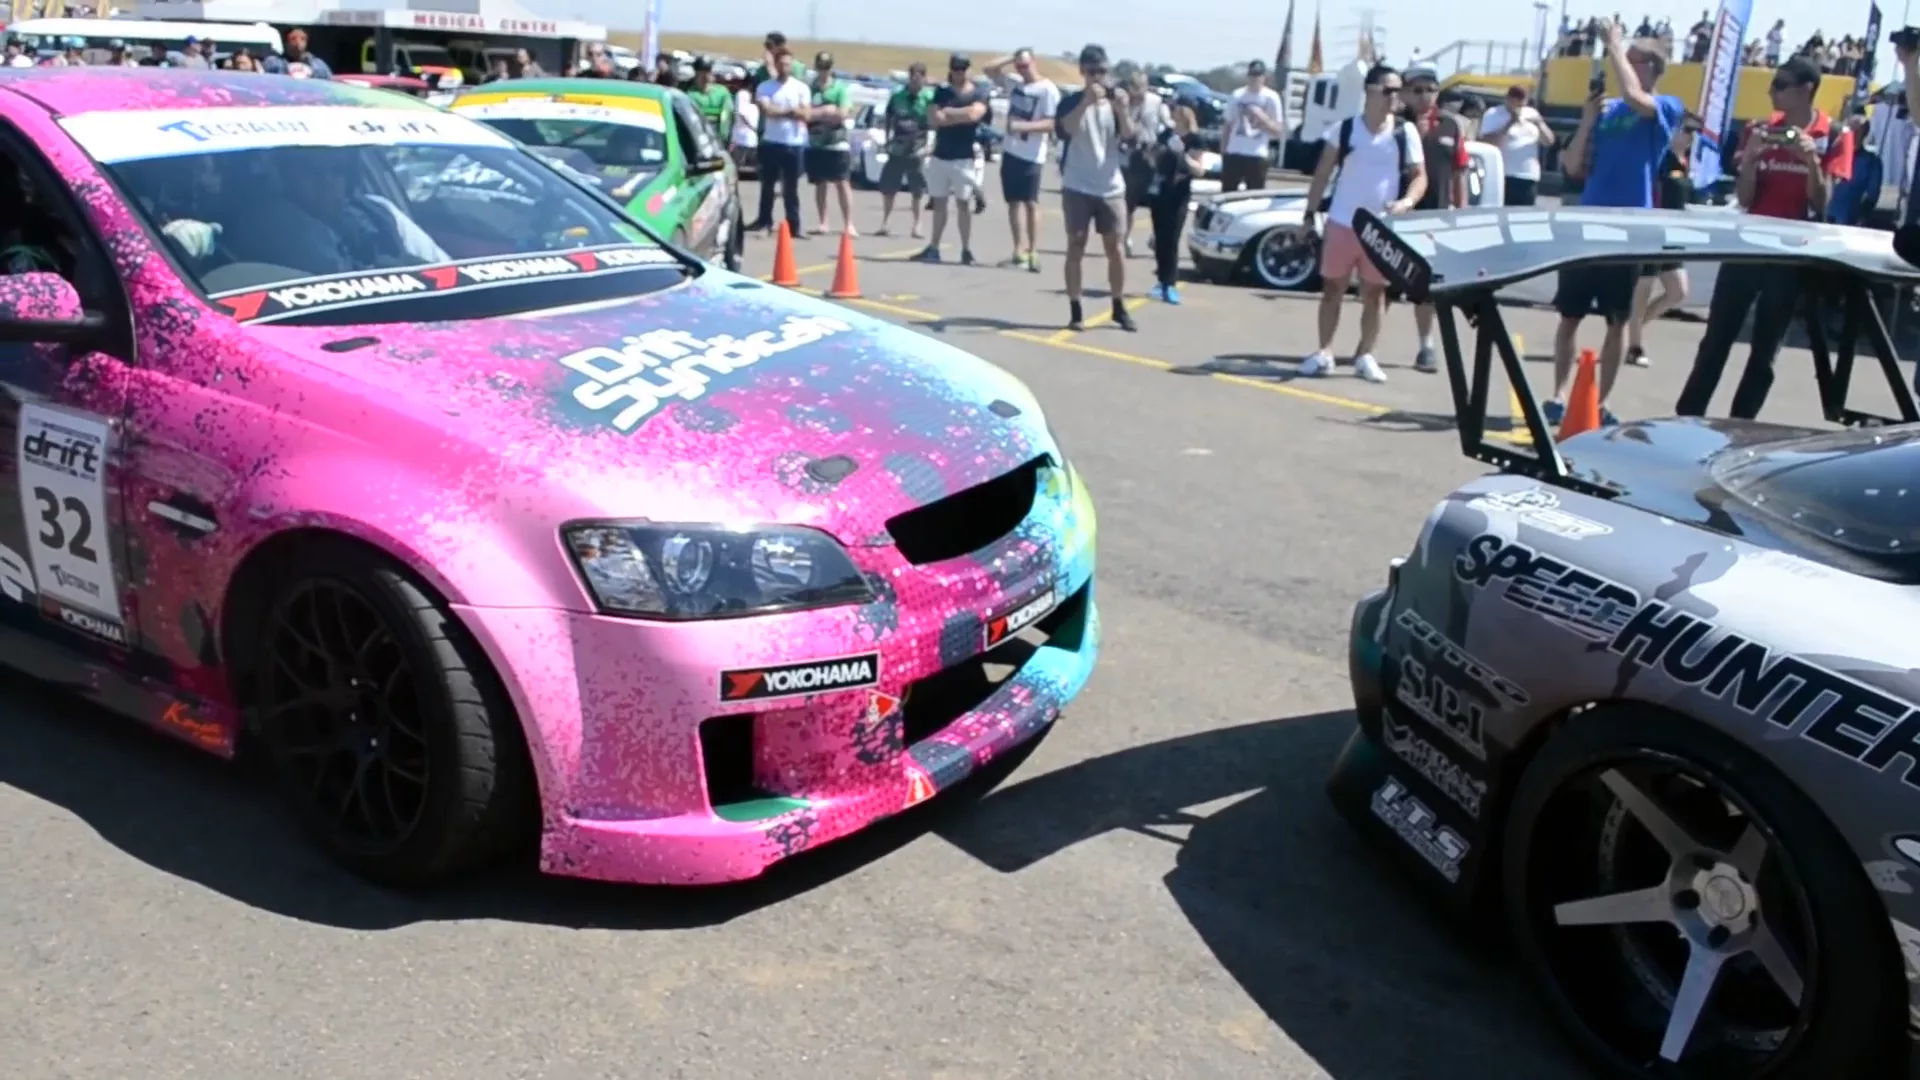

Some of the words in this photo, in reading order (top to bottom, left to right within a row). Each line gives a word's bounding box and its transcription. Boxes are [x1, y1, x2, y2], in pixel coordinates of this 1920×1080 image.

[413, 13, 486, 30] MEDICAL
[499, 19, 557, 33] CENTRE
[1361, 222, 1405, 270] Mobil
[269, 273, 427, 309] YOKOHAMA
[460, 256, 577, 283] YOKOHAMA
[558, 328, 710, 386] Drift
[24, 430, 99, 474] drift
[34, 486, 97, 564] 32
[763, 660, 873, 693] YOKOHAMA
